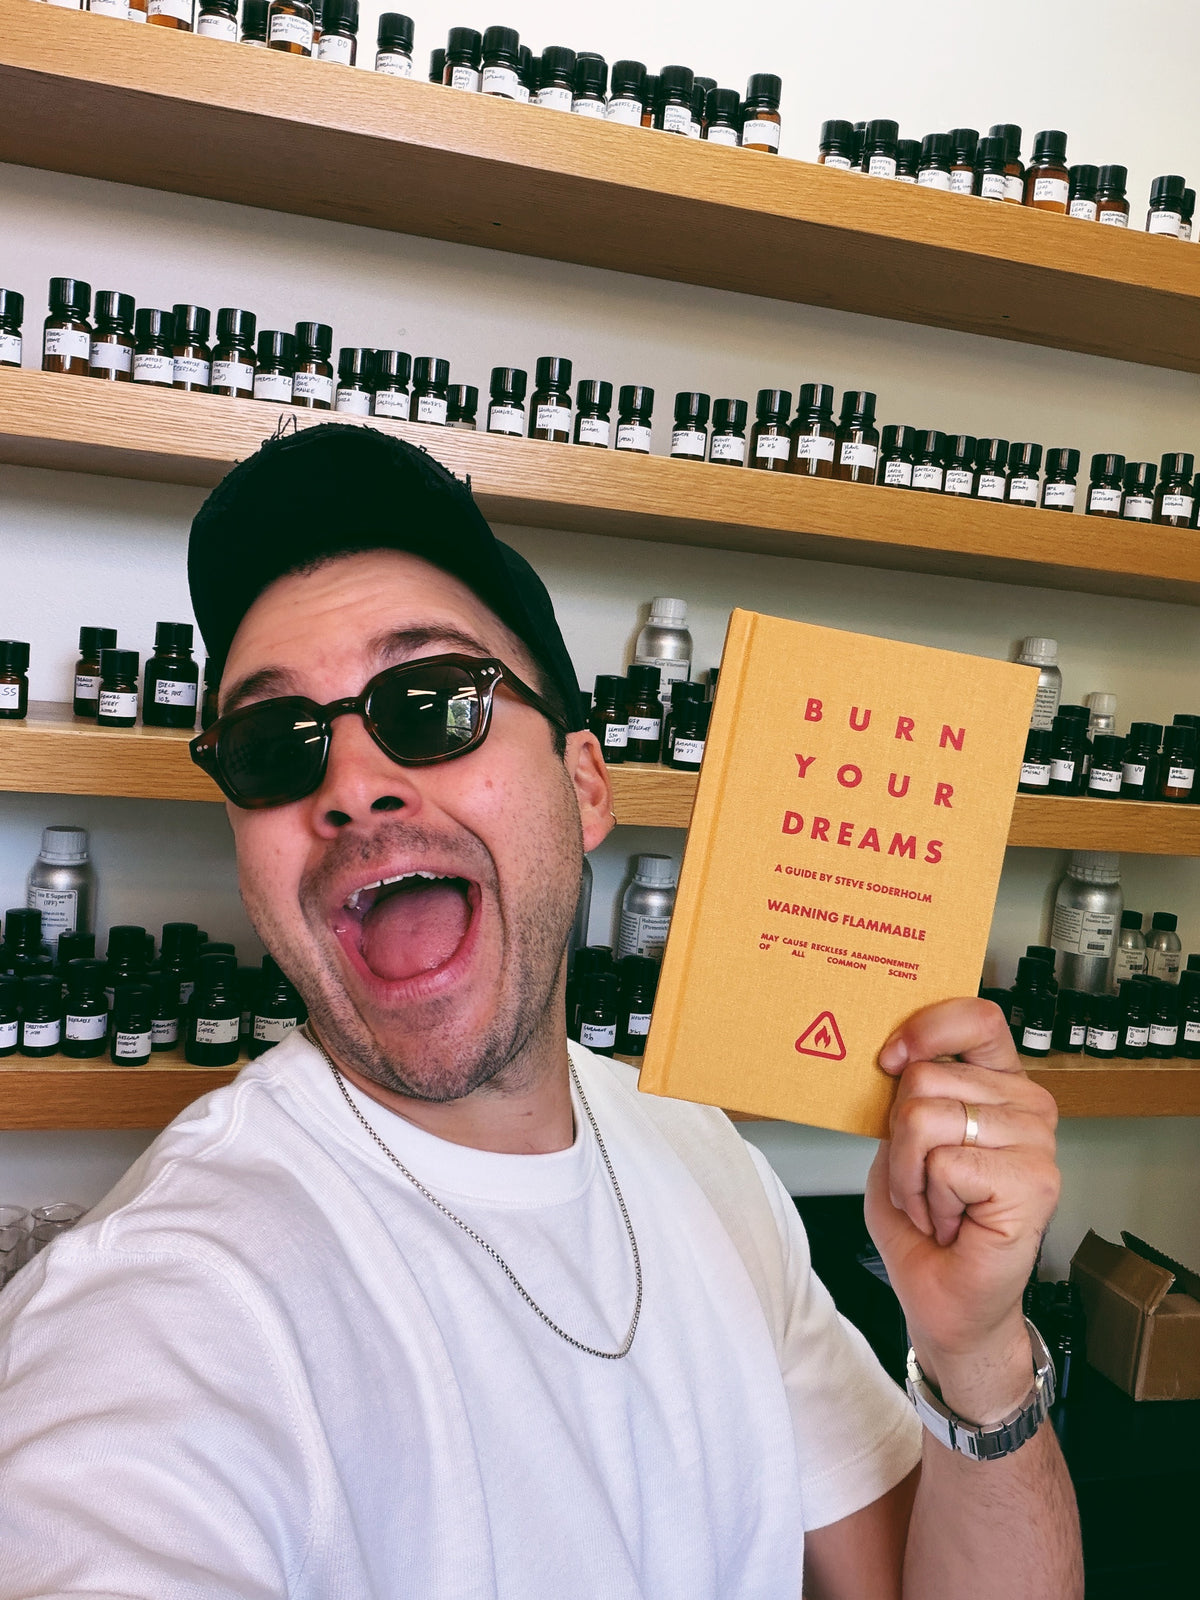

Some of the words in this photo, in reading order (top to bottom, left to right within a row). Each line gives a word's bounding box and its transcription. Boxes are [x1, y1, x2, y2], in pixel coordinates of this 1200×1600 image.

[804, 698, 966, 751] BURN
[794, 753, 954, 808] YOUR
[782, 810, 944, 865] DREAMS
[774, 864, 783, 873] A
[785, 866, 818, 880] GUIDE
[819, 872, 833, 883] BY
[834, 876, 865, 890] STEVE
[866, 882, 933, 903] SODERHOLM
[767, 899, 840, 924] WARNING
[841, 914, 927, 942] FLAMMABLE
[758, 942, 771, 951] OF
[791, 949, 806, 959] ALL
[826, 956, 867, 971] COMMON
[887, 968, 918, 981] SCENTS
[760, 932, 780, 944] MAY
[782, 937, 808, 949] CAUSE
[810, 943, 849, 957] RECKLESS
[850, 951, 920, 971] ABANDONEMENT
